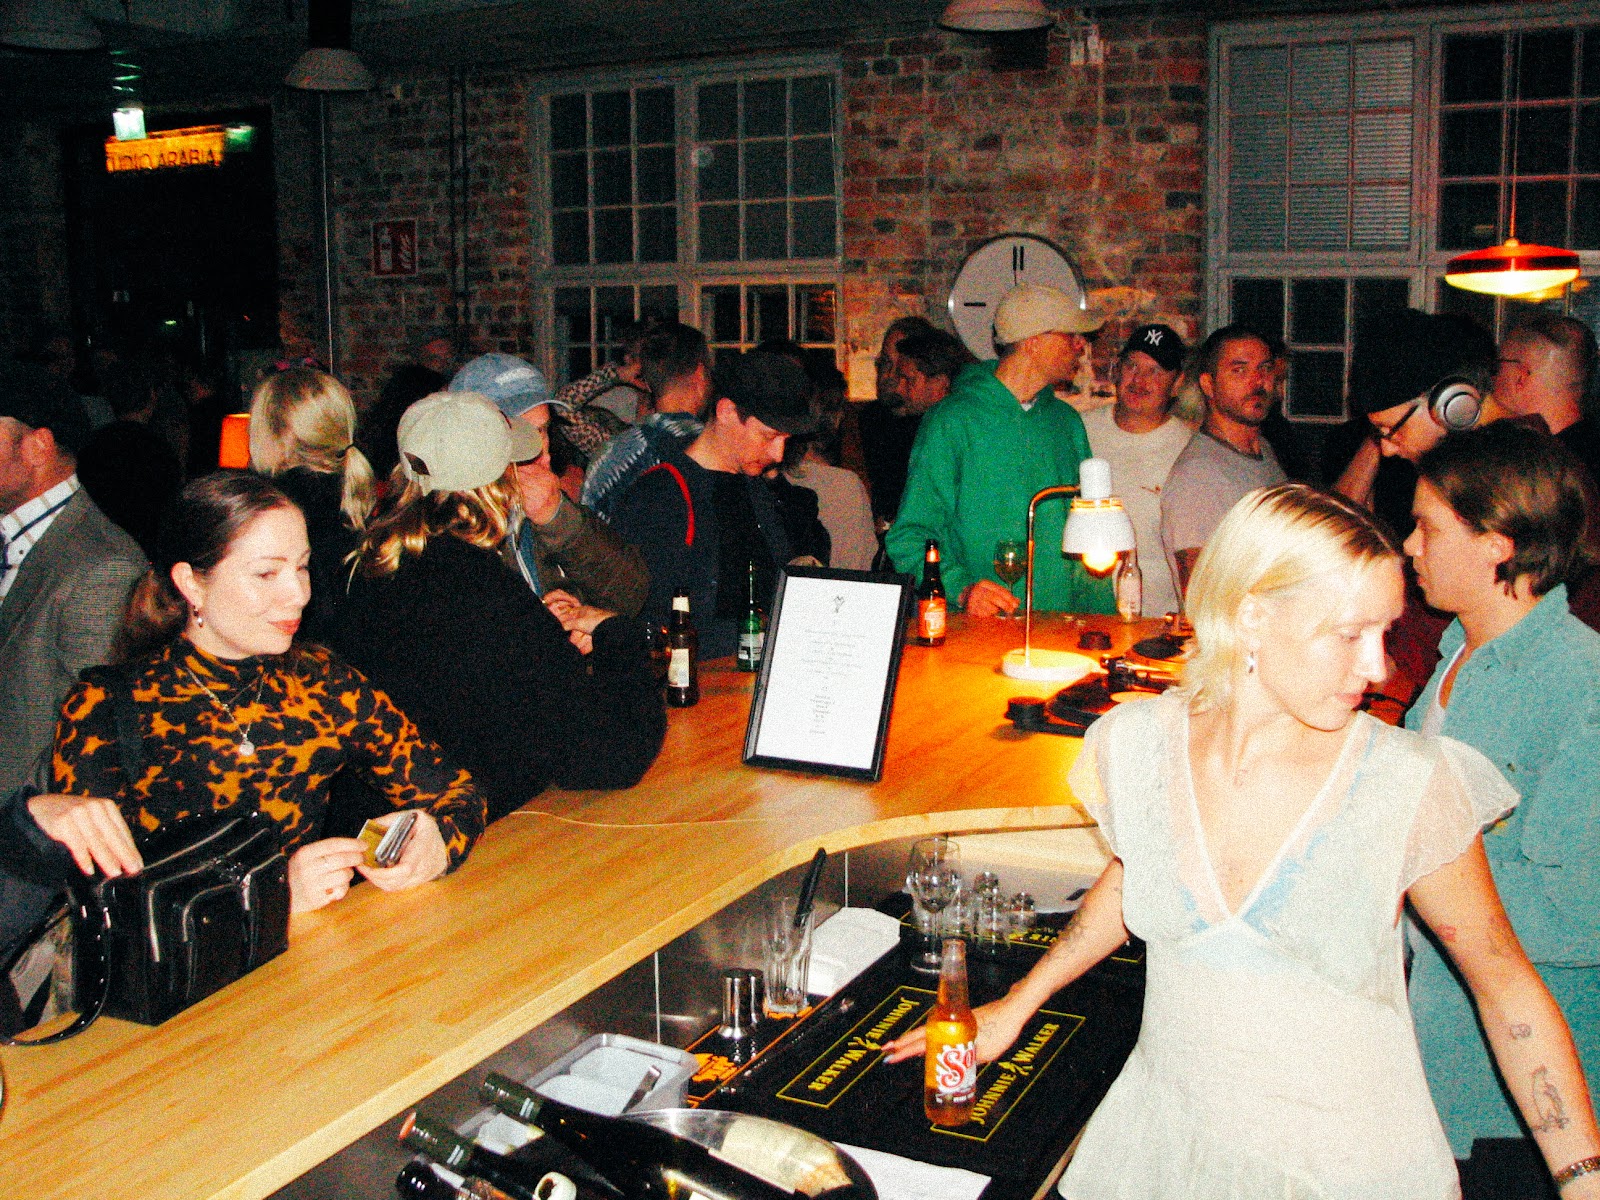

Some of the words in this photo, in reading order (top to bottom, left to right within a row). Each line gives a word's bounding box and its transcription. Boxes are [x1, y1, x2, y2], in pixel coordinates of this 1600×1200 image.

[1144, 329, 1164, 346] NY
[865, 997, 920, 1040] JOHNNIE
[808, 1049, 868, 1091] WALKER
[970, 1072, 1017, 1125] JOHNNIE
[1011, 1023, 1060, 1063] WALKER
